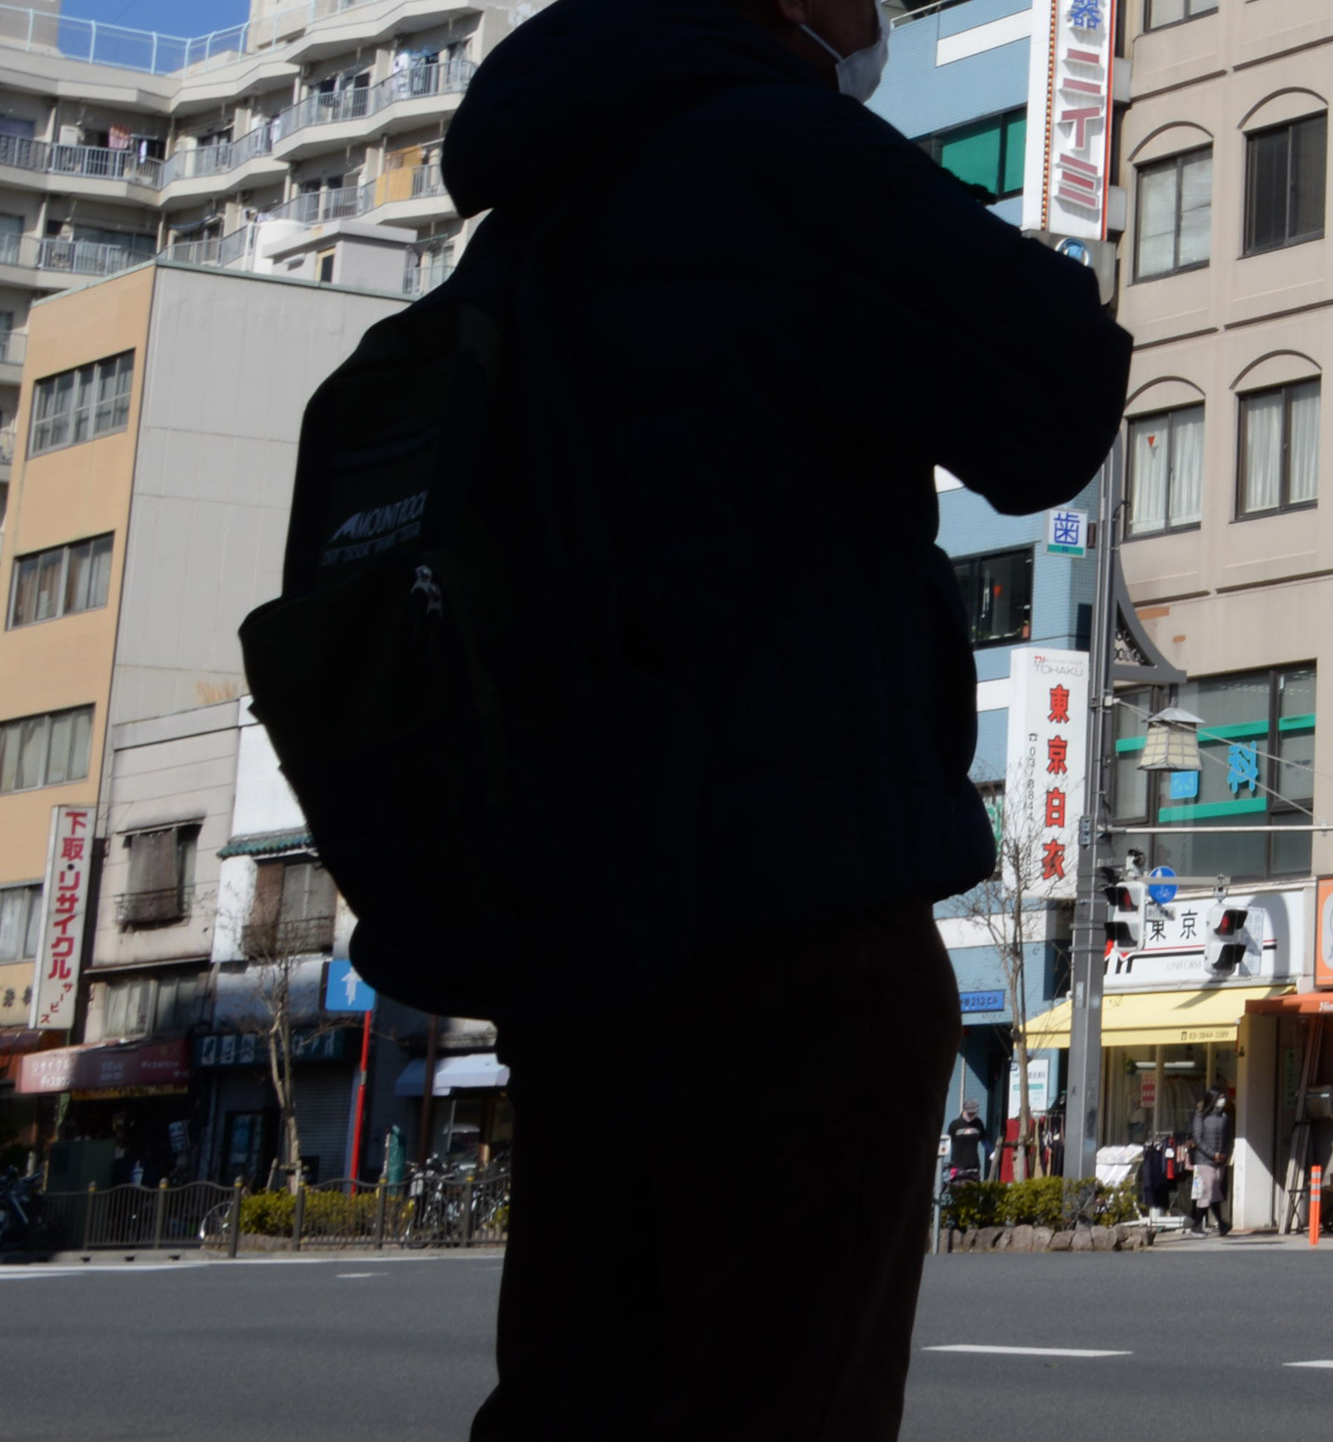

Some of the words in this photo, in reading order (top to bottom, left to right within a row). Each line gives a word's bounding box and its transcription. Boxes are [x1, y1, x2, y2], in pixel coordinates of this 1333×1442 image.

[1055, 47, 1101, 209] ニイミ
[1053, 512, 1080, 545] 歯
[1041, 684, 1070, 881] 東京白衣
[48, 812, 88, 981] 下取・リサイクル
